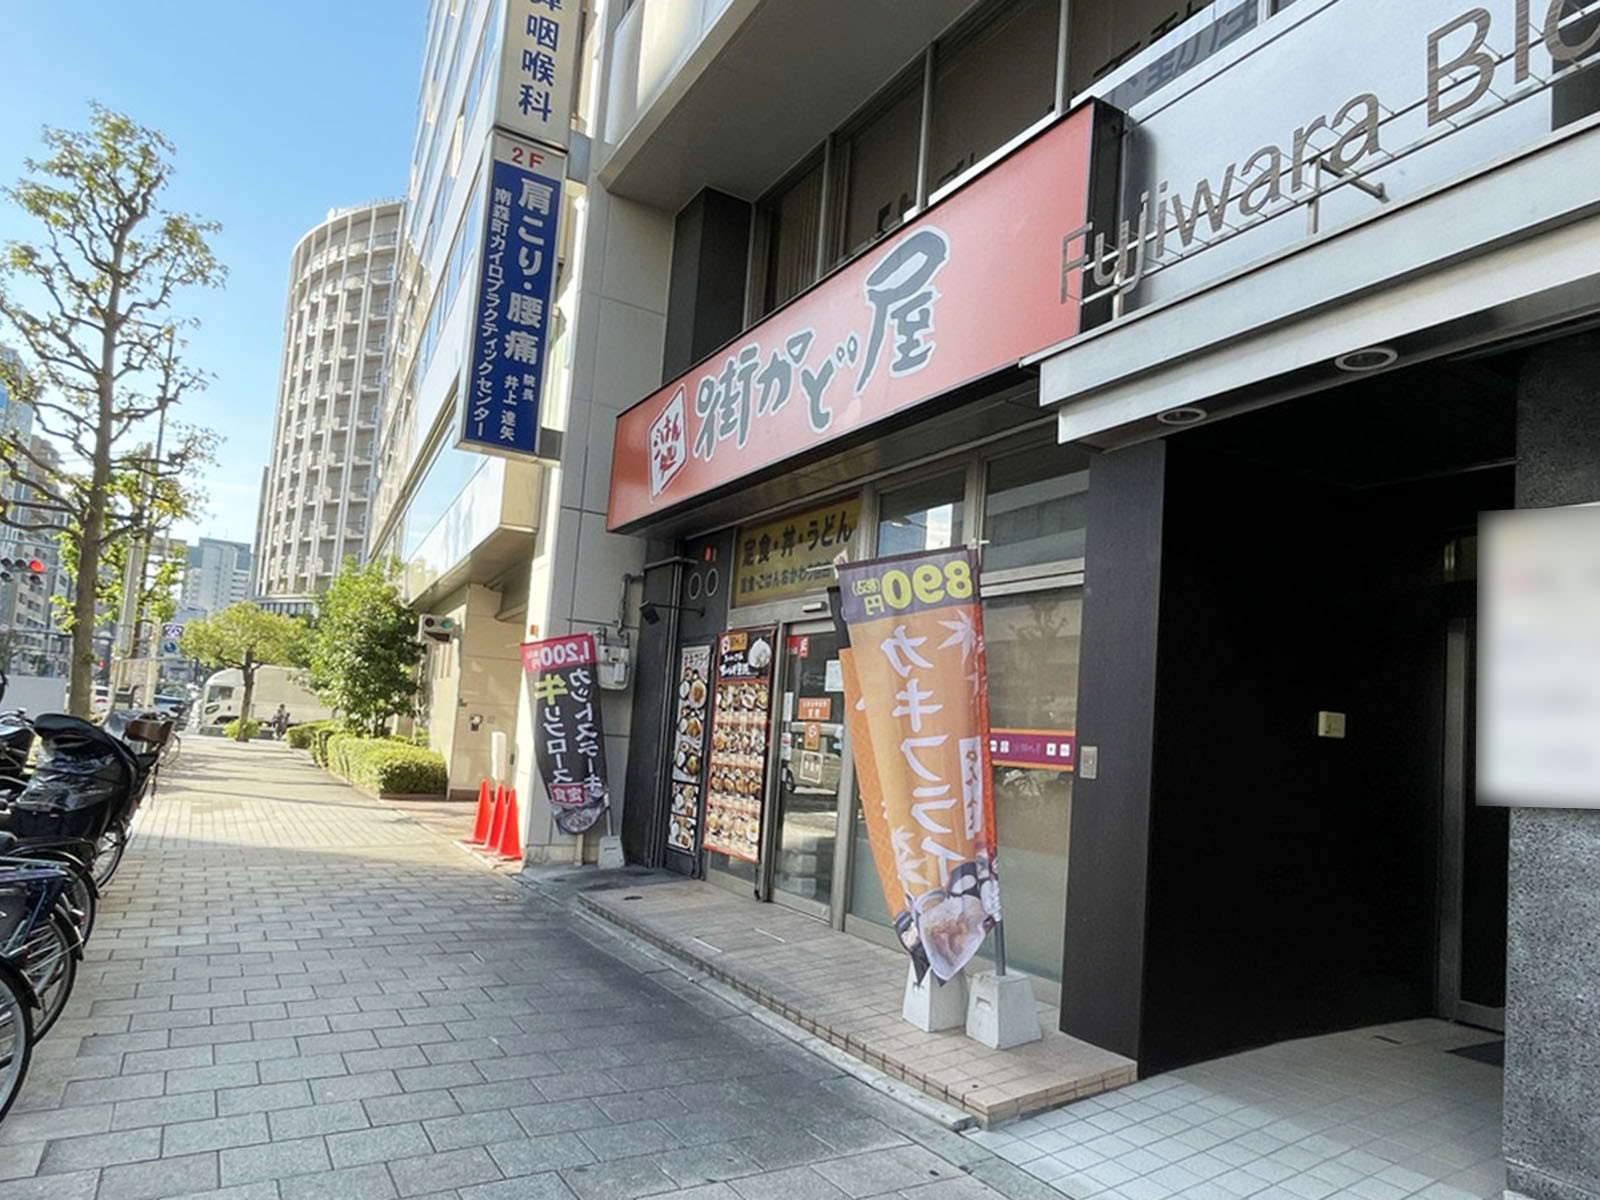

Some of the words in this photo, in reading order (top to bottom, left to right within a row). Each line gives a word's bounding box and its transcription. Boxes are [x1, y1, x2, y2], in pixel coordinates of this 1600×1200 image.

[511, 145, 545, 170] 2F
[1060, 92, 1381, 305] Fujiwara
[504, 178, 554, 365] 肩こり・腰痛
[693, 223, 950, 462] 街かど屋
[503, 375, 520, 406] 井上
